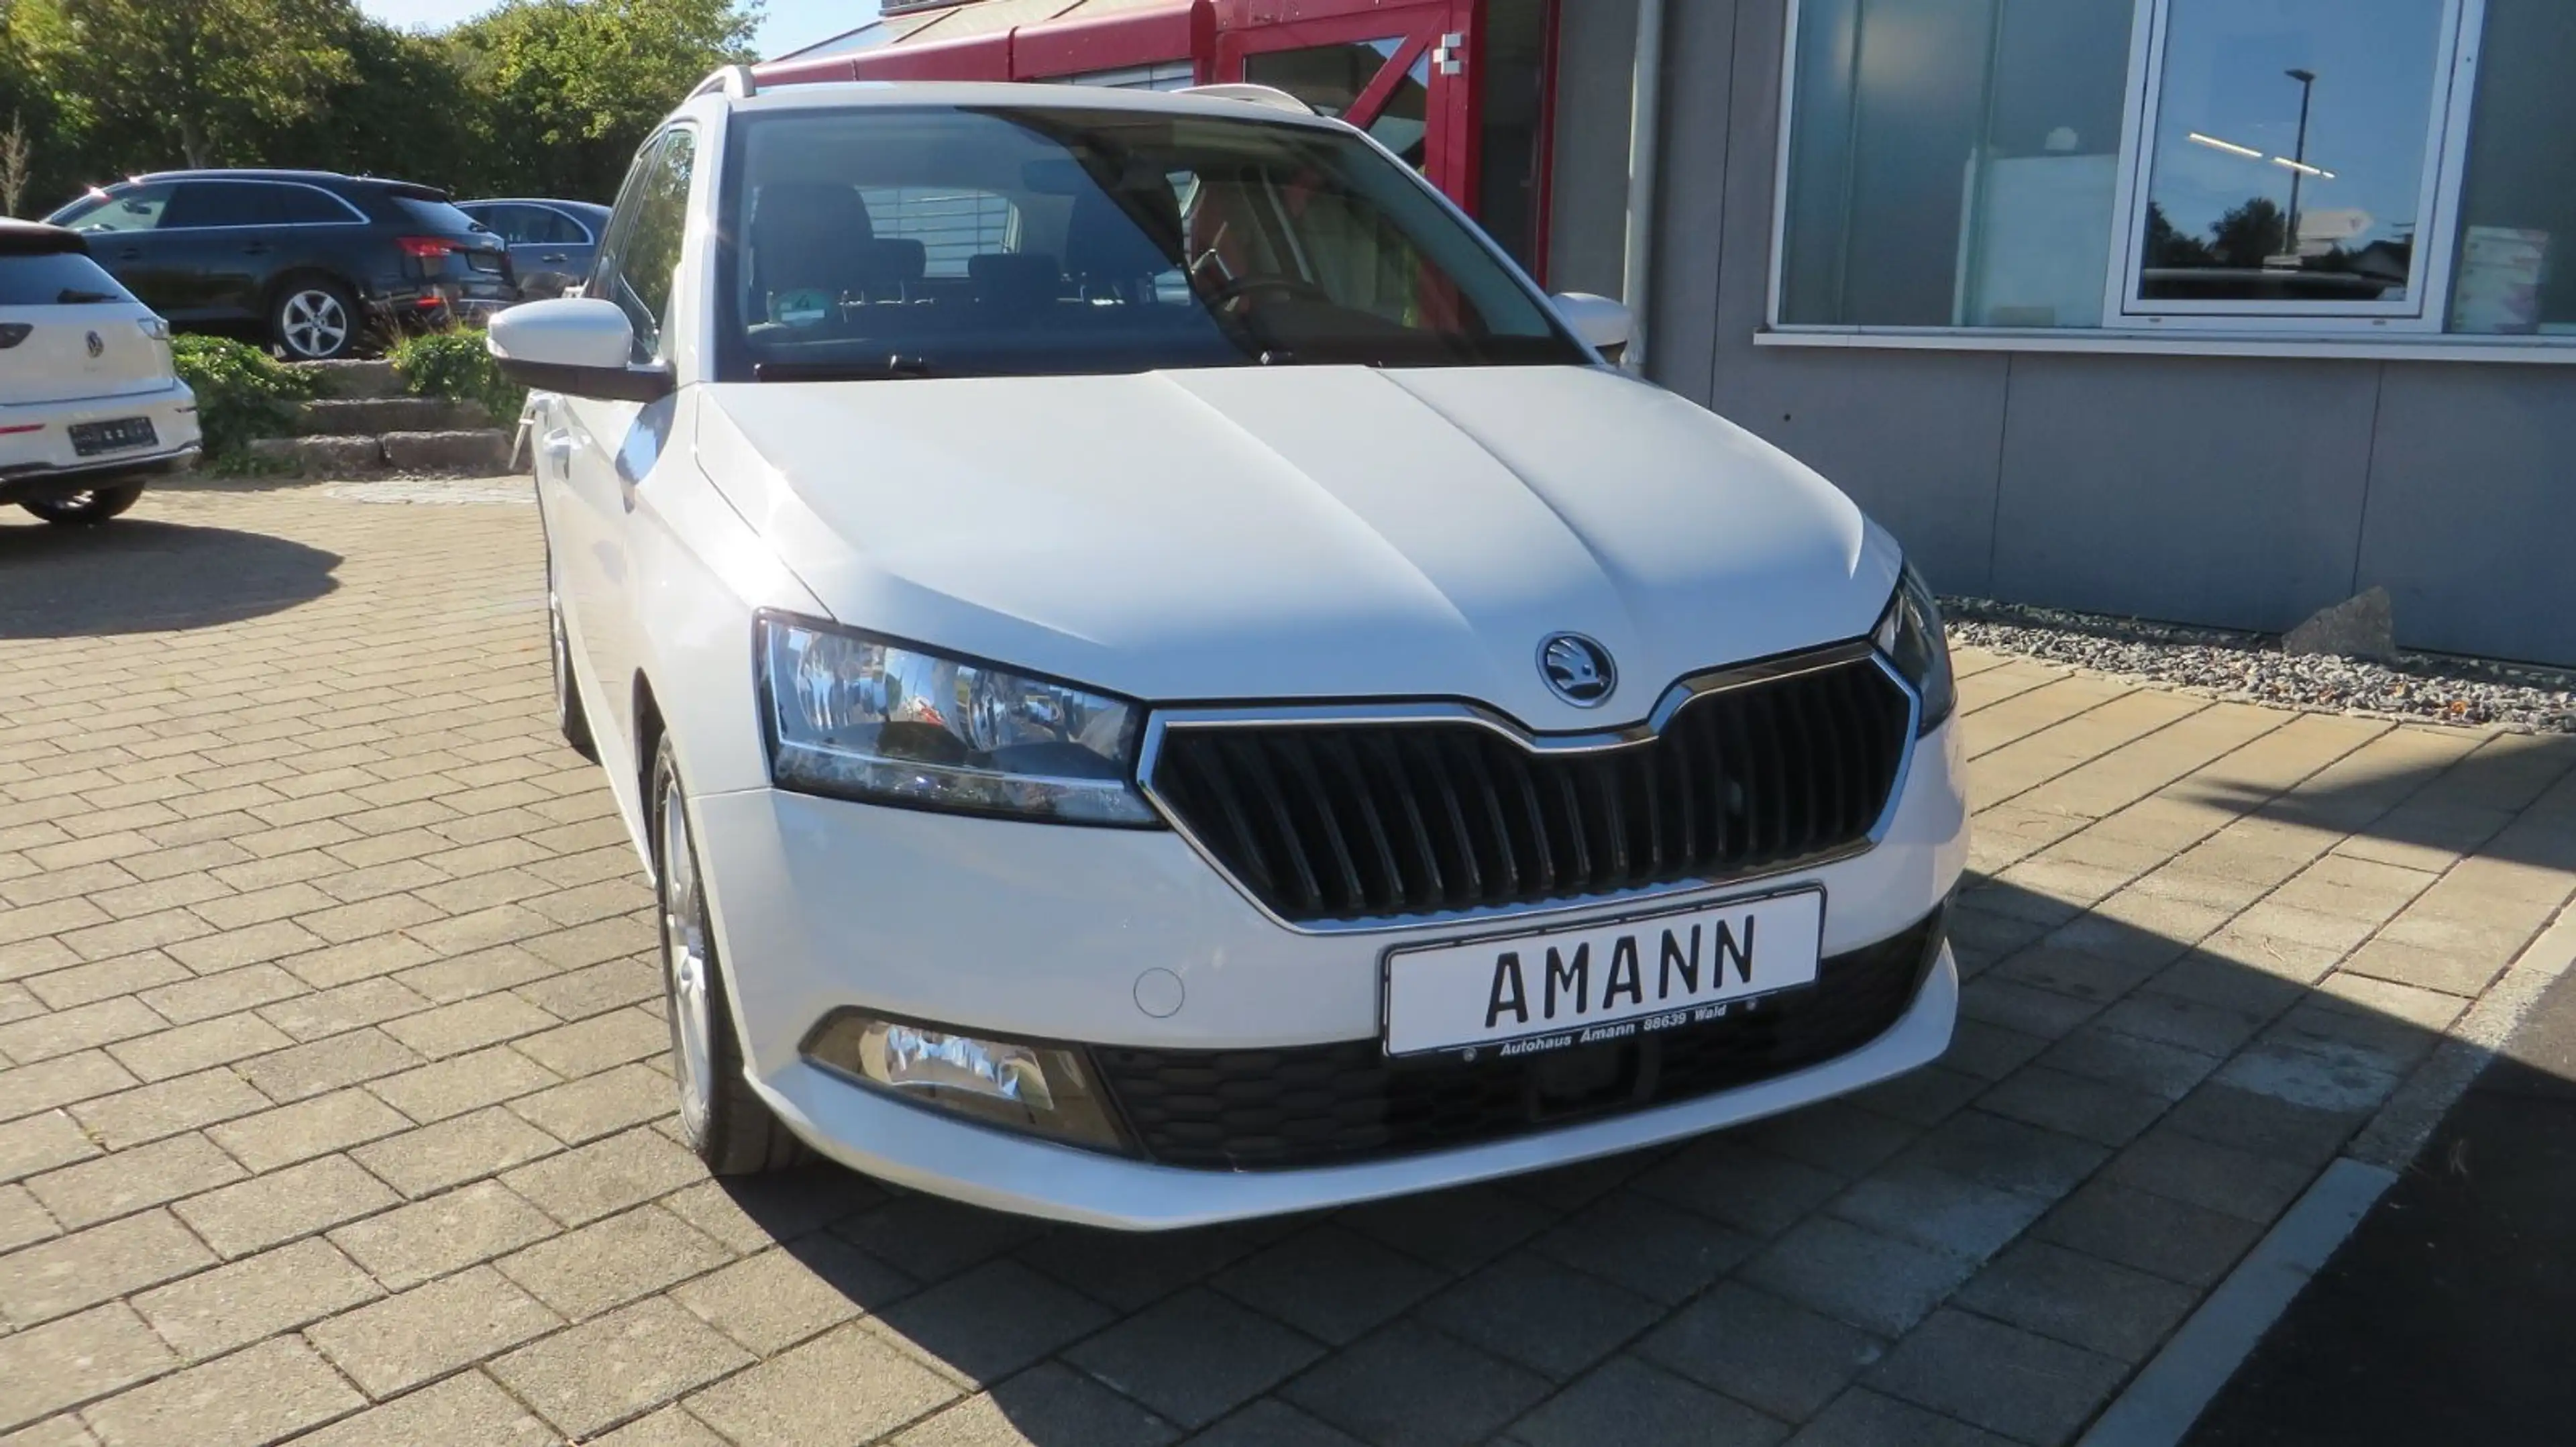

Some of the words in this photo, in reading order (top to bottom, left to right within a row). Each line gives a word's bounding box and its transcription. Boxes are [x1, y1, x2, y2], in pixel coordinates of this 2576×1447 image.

[1485, 914, 1755, 1028] AMANN
[1499, 1034, 1572, 1057] Autohaus
[1580, 1021, 1636, 1043] Amann
[1643, 1011, 1687, 1032] 88639
[1694, 1004, 1727, 1022] Wald
